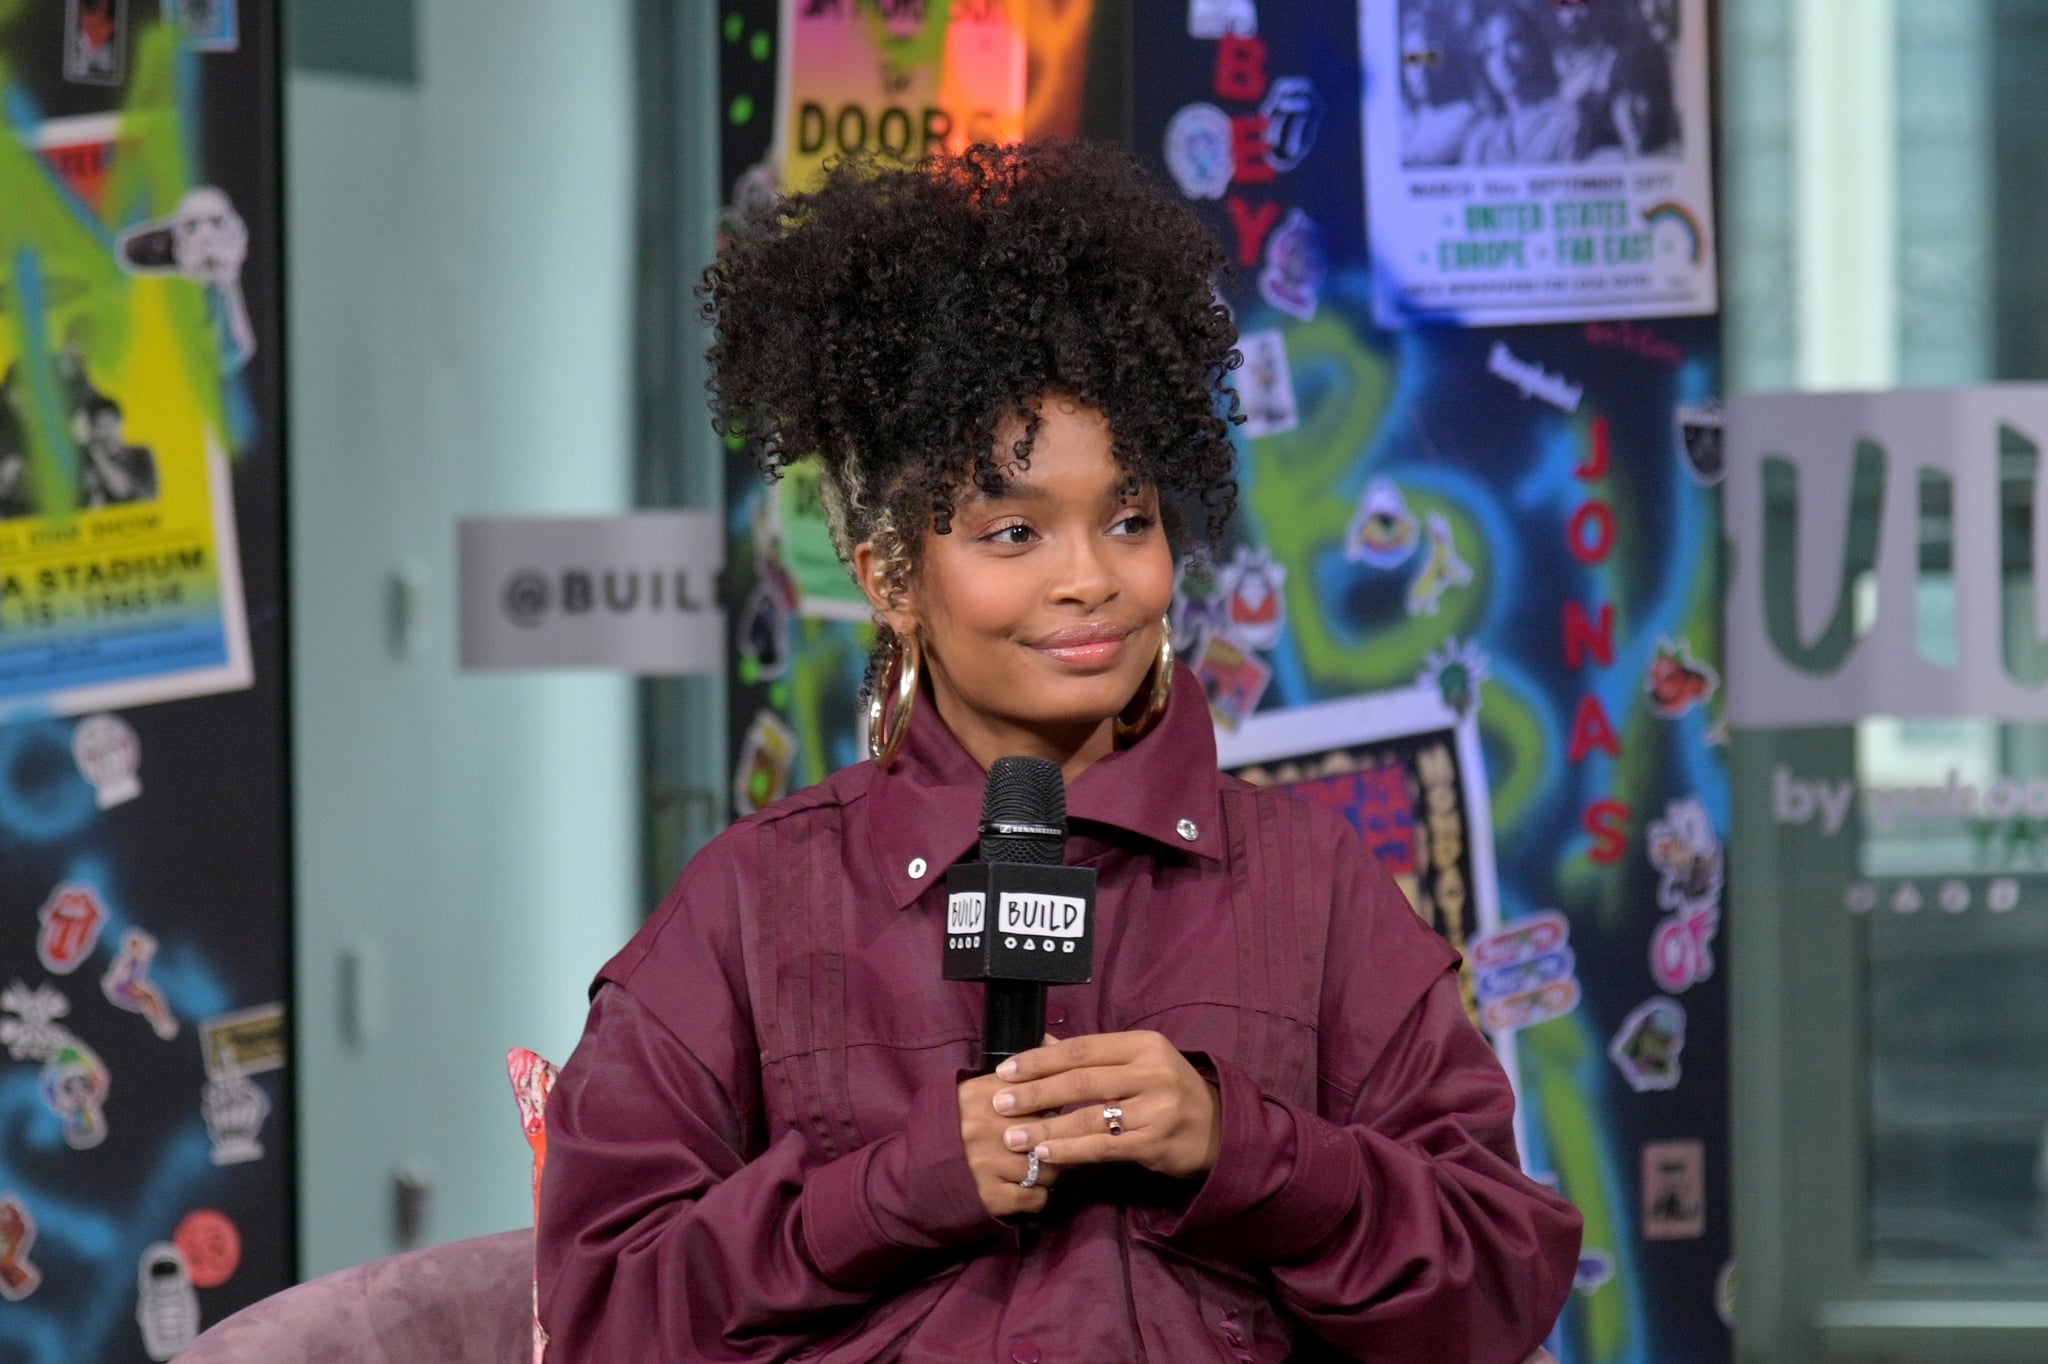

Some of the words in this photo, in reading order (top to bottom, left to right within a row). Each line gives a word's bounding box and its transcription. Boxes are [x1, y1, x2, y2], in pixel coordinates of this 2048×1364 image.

[1214, 33, 1280, 266] BEY
[1466, 203, 1543, 233] UNITED
[1553, 200, 1627, 230] STATES
[1438, 240, 1527, 271] EUROPE
[1556, 236, 1595, 264] FAR
[1603, 233, 1653, 262] EAST
[39, 550, 205, 592] STADIUM
[1754, 421, 2048, 690] UIL
[1564, 414, 1633, 866] JONAS
[1774, 766, 1853, 835] by
[951, 897, 982, 928] BUILD
[1008, 899, 1078, 931] BUILD
